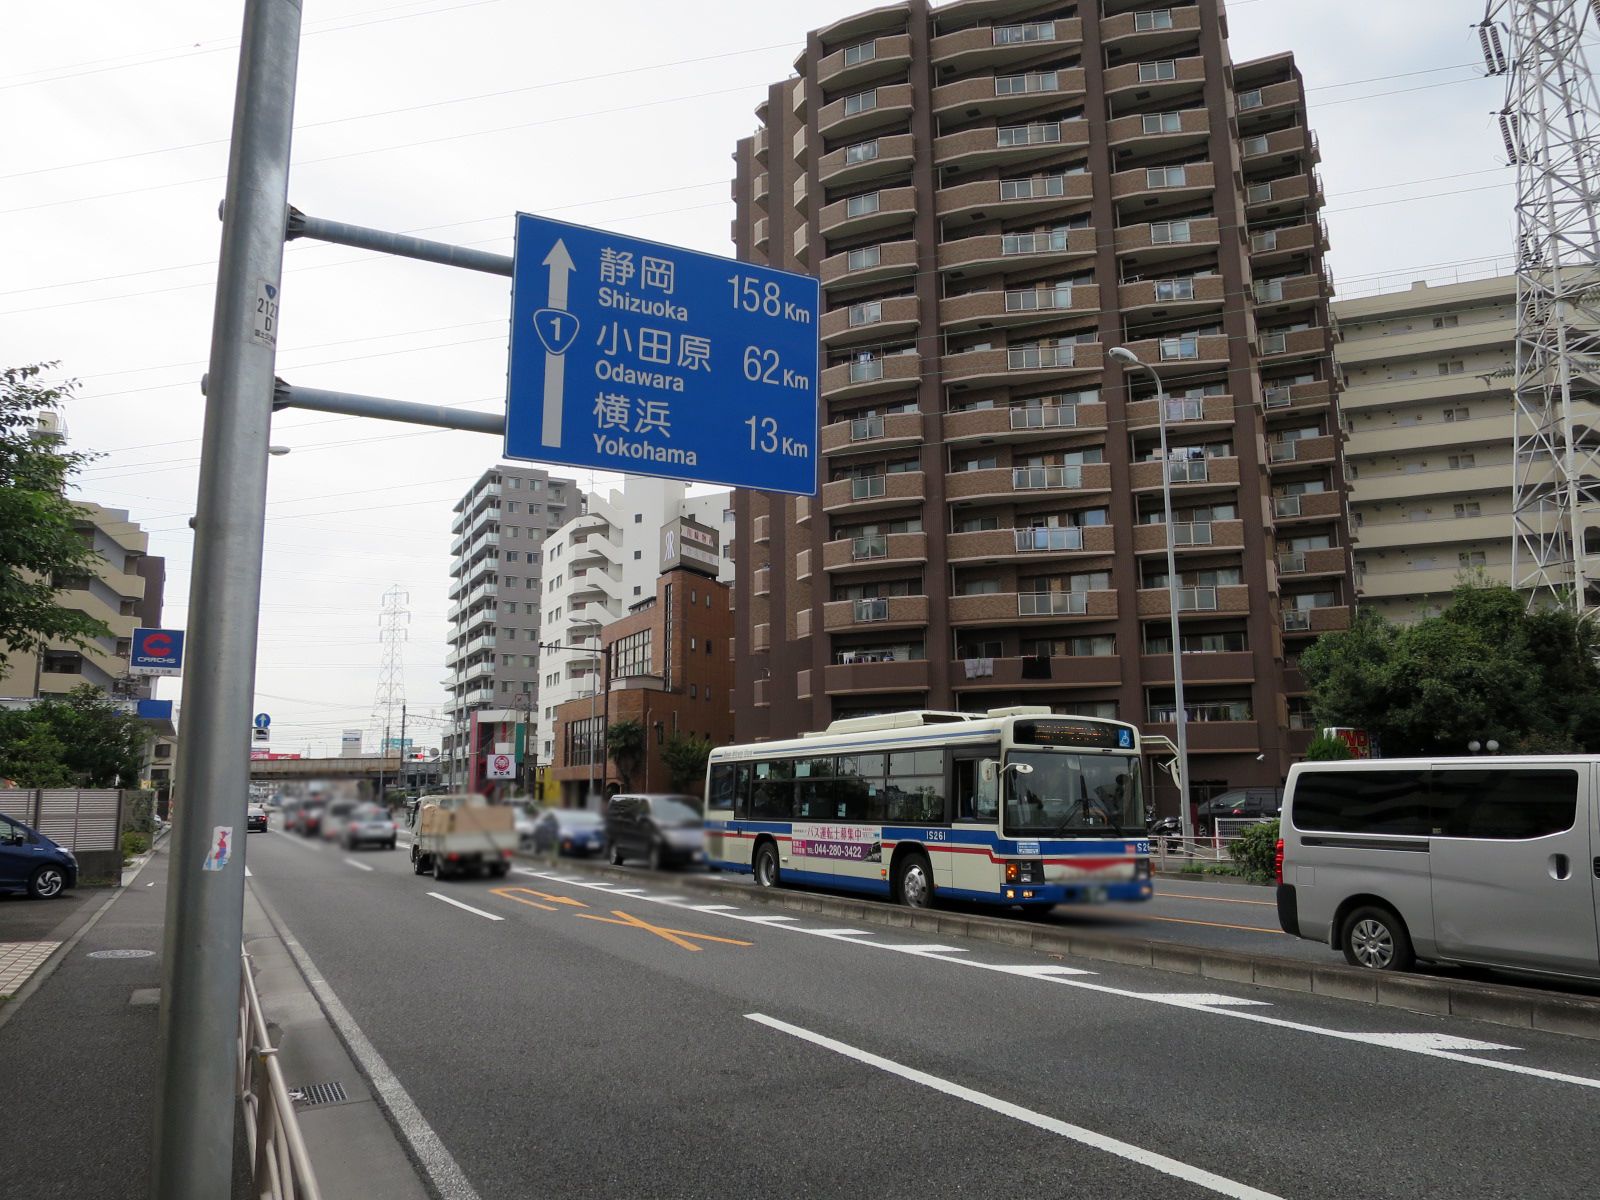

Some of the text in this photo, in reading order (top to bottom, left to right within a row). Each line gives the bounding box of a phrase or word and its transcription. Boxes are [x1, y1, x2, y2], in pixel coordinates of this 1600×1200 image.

[599, 247, 675, 295] 静岡
[598, 287, 688, 321] Shizuoka
[550, 317, 561, 341] 1
[596, 321, 712, 373] 小田原
[595, 360, 684, 392] Odawara
[592, 392, 671, 438] 横浜
[593, 434, 697, 465] Yokohama
[807, 826, 862, 841] バス運転士募集中
[814, 843, 862, 857] 044-280-3422
